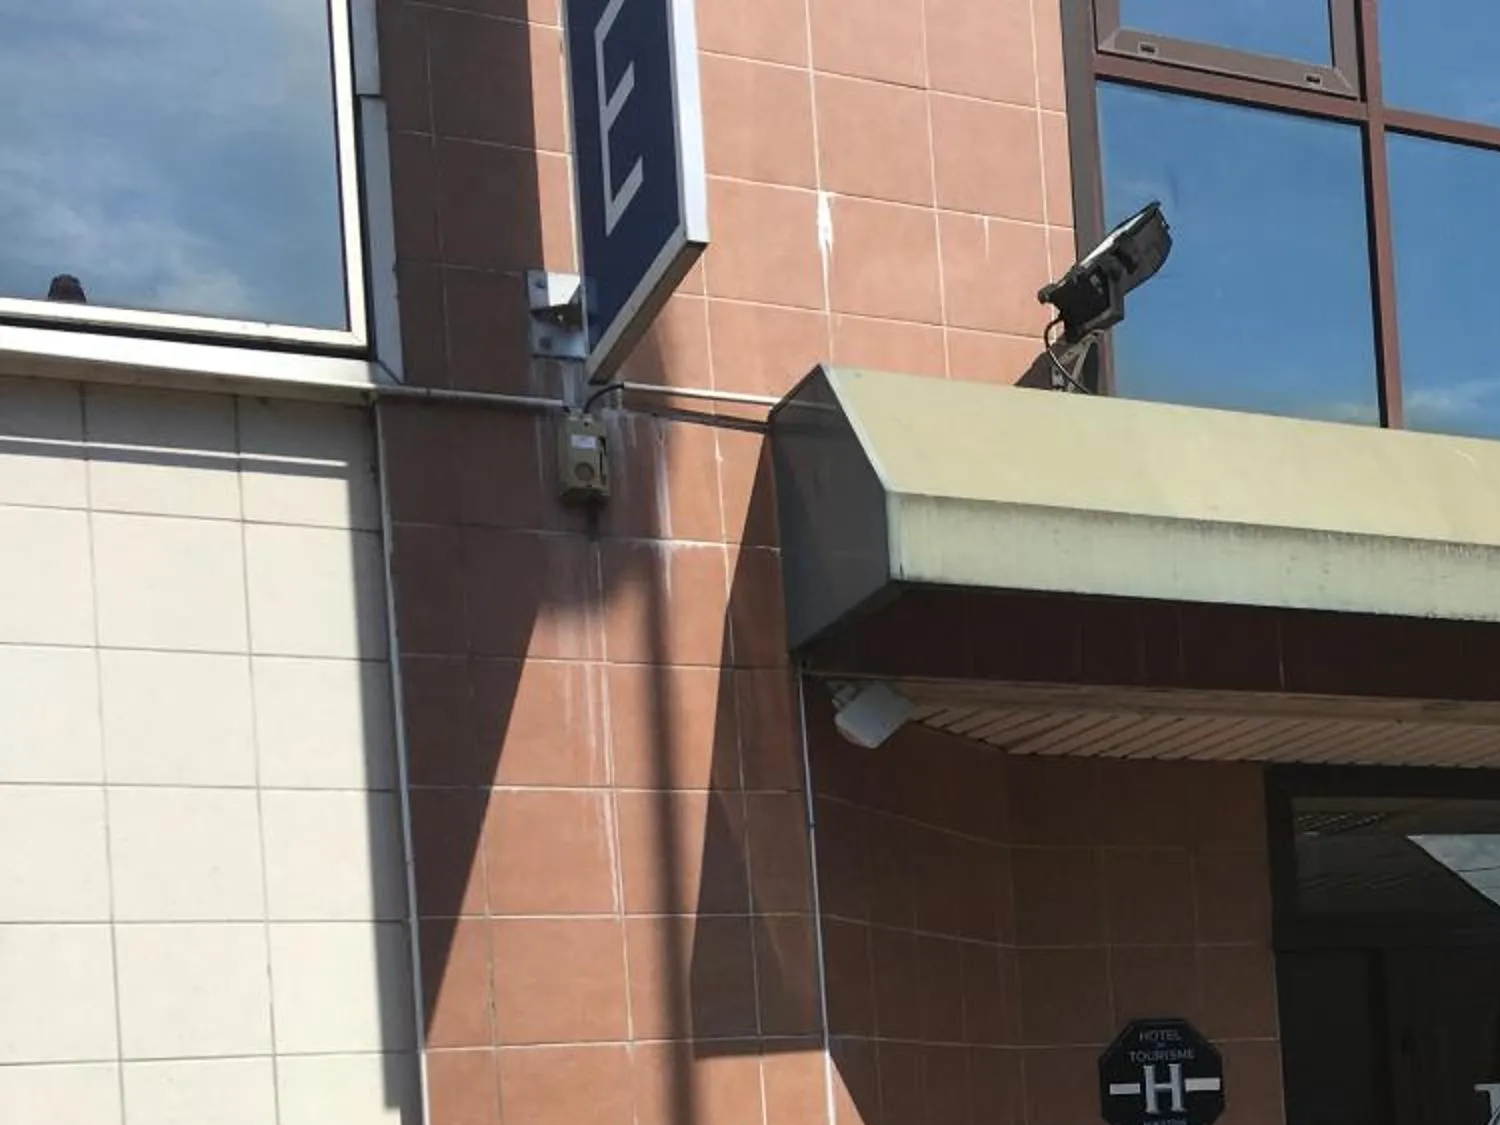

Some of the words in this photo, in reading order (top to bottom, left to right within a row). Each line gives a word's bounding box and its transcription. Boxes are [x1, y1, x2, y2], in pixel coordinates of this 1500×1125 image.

[594, 0, 644, 237] E
[1138, 1028, 1182, 1042] HOTEL
[1128, 1047, 1195, 1063] TOURISME
[1142, 1062, 1187, 1114] H
